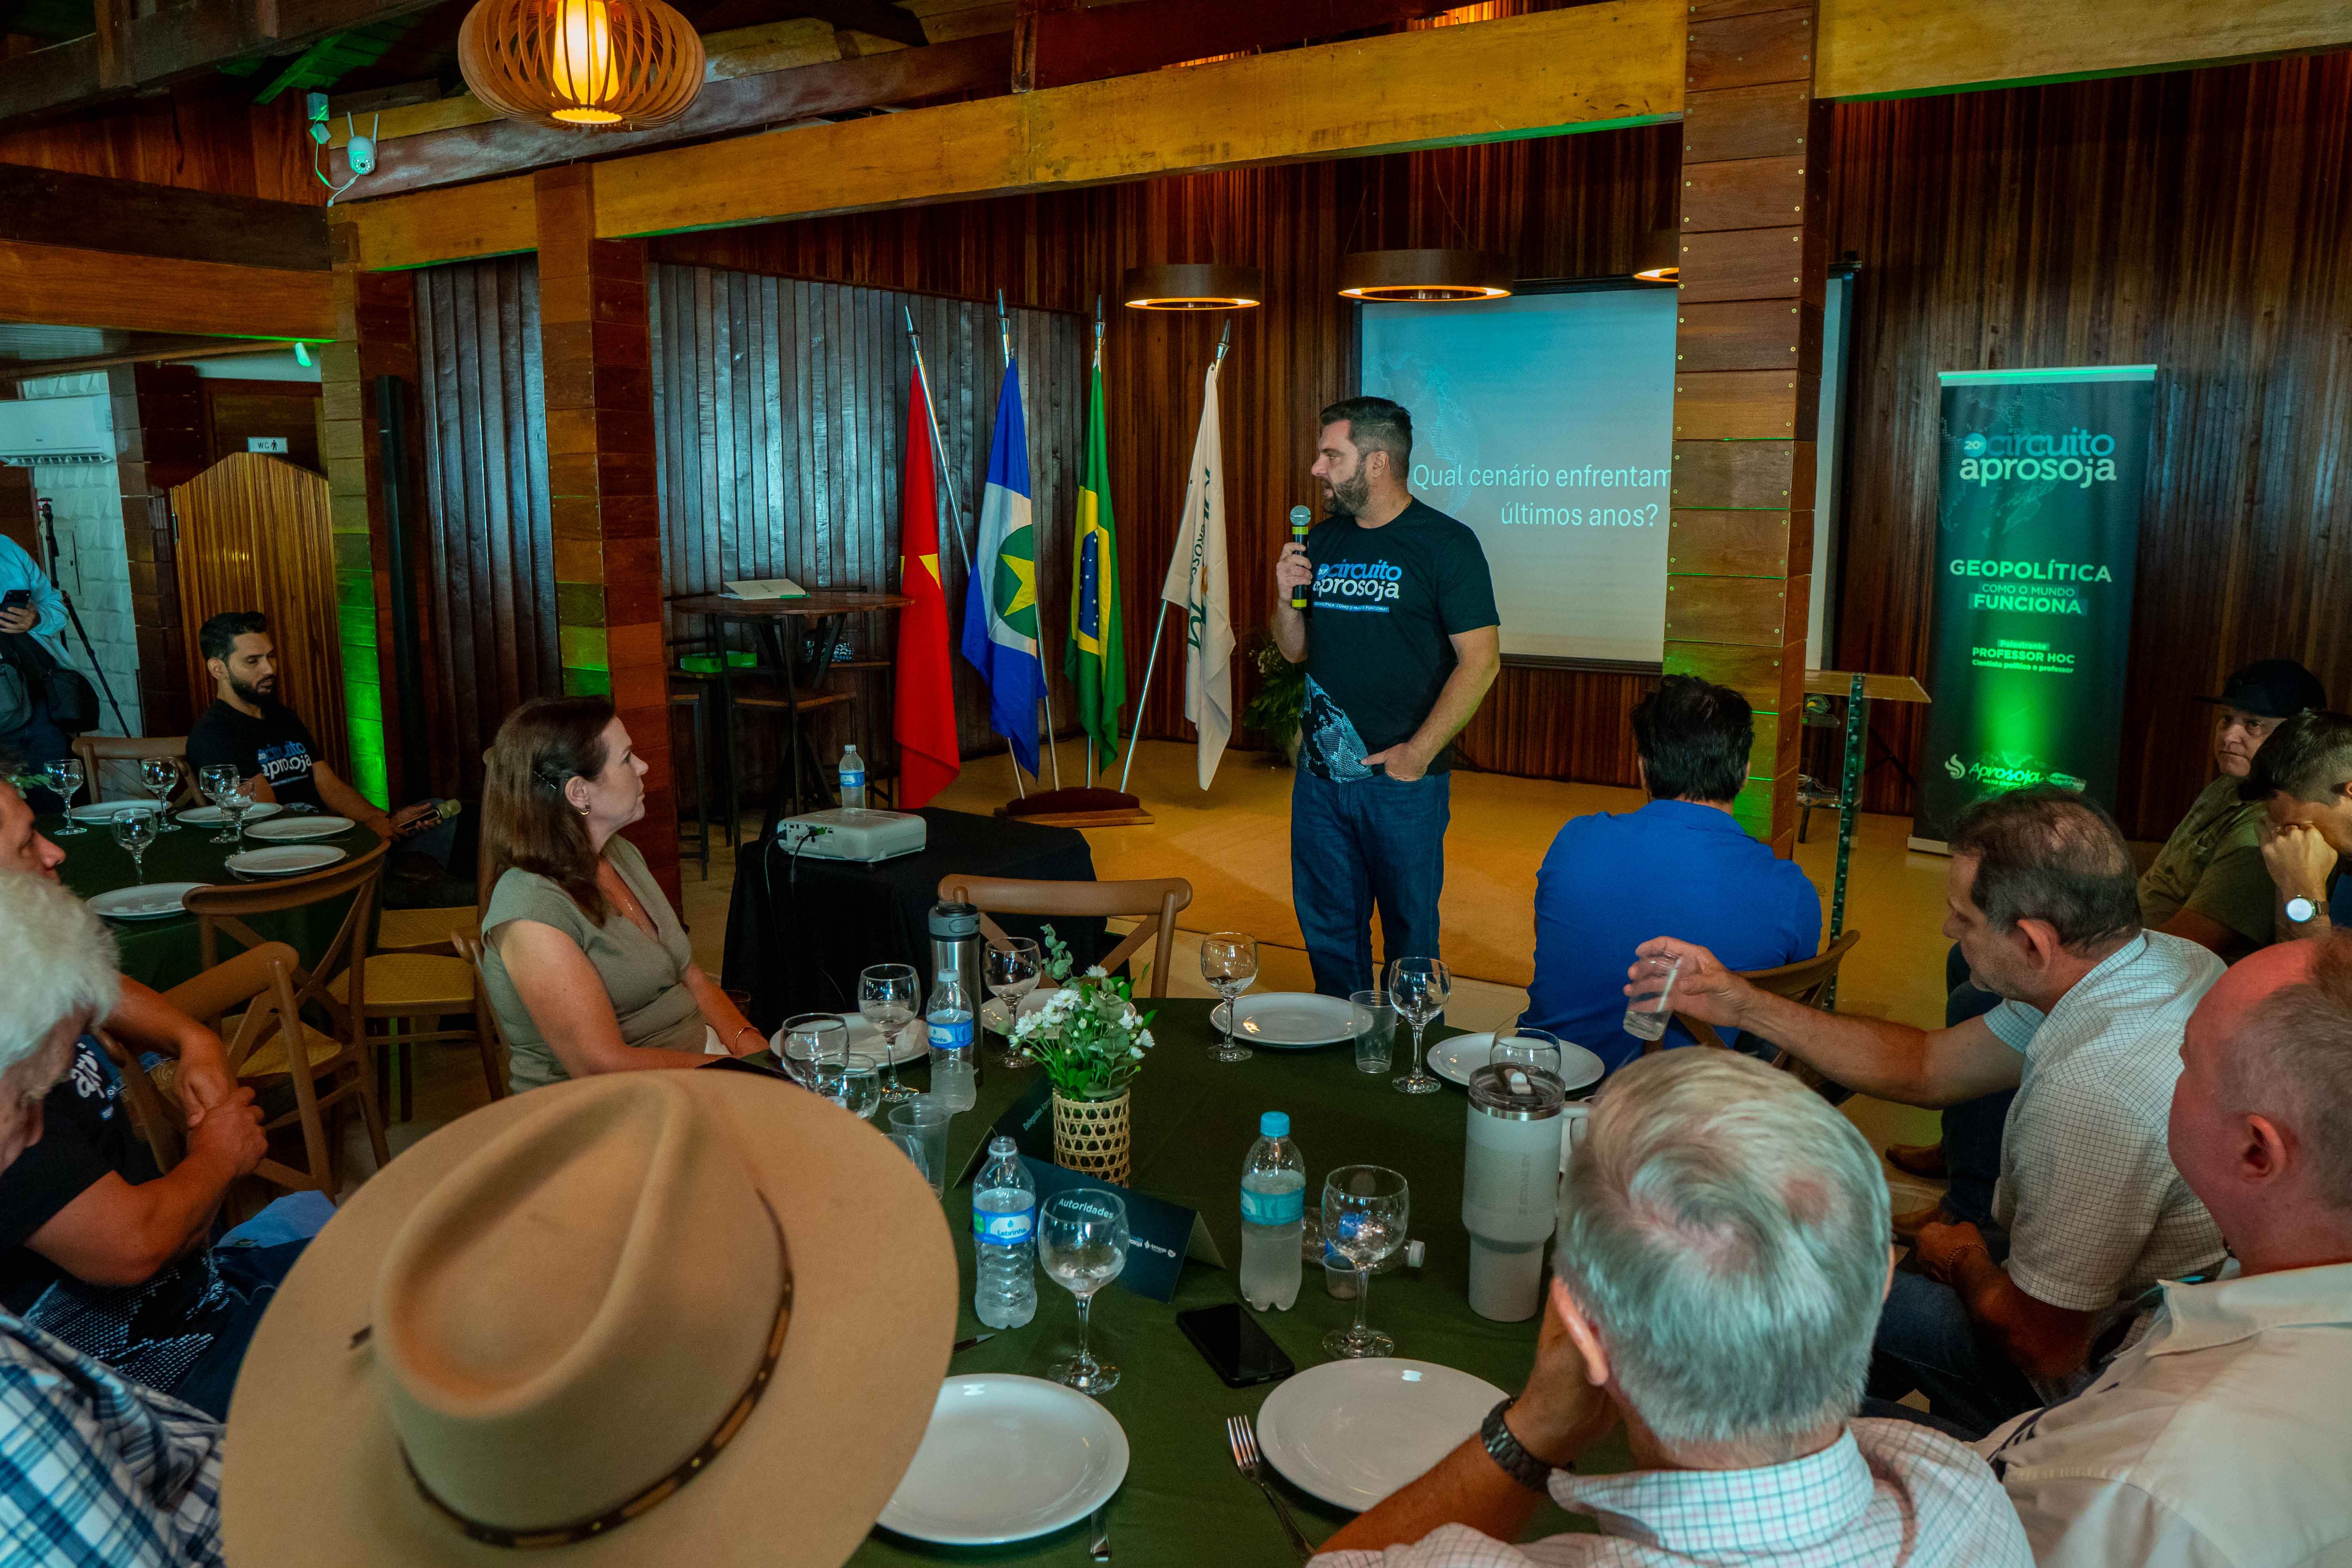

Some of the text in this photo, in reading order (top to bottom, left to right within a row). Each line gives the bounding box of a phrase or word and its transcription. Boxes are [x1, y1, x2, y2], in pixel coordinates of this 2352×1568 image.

[1986, 426, 2115, 457] circuito
[1413, 464, 1463, 490] Qual
[1469, 464, 1549, 487] cenário
[1960, 458, 2117, 488] aprosoja
[1501, 502, 1658, 526] últimos anos?
[1326, 559, 1402, 581] circuito
[1949, 559, 2112, 583] GEOPOLÍTICA
[1312, 578, 1400, 601] aprosoja
[1982, 583, 2075, 597] COMO O MUNDO
[1974, 594, 2082, 614] FUNCIONA
[1972, 647, 2075, 664] PROFESSOR HOC
[2038, 665, 2074, 673] professor
[1968, 762, 2044, 786] Aprosoja
[1058, 1198, 1114, 1219] Autoridades
